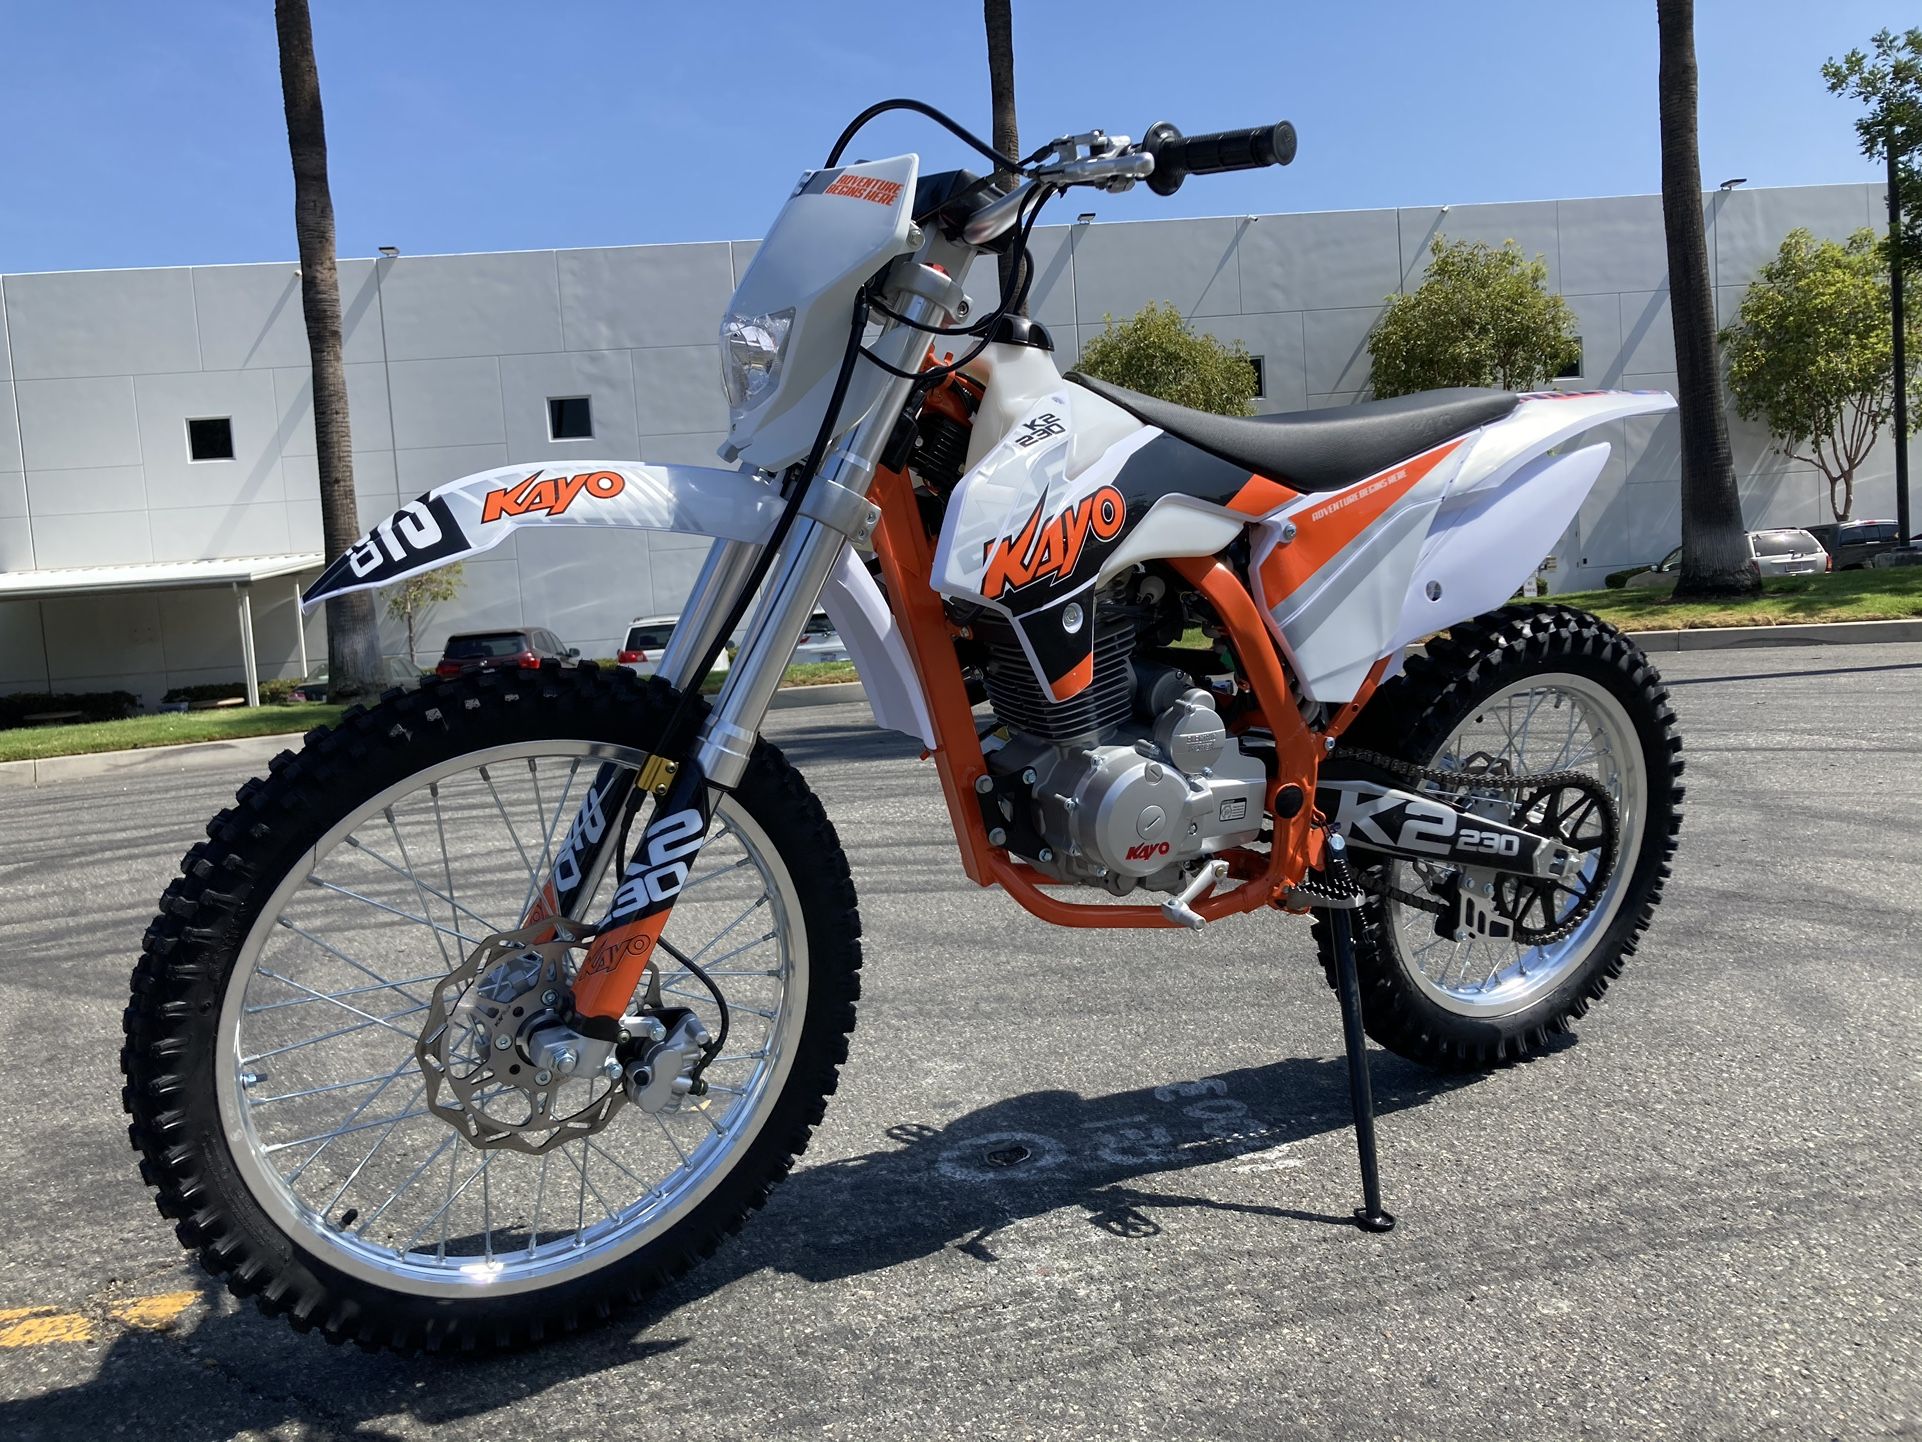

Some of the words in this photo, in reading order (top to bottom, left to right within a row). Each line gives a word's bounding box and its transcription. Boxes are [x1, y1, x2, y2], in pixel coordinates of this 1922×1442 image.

[825, 184, 867, 199] BEGINS
[863, 190, 898, 206] HERE
[835, 174, 905, 195] ADVENTURE
[1023, 413, 1061, 431] K2
[1015, 423, 1066, 448] 230
[480, 469, 626, 524] KAYO
[1311, 493, 1360, 522] ADVENTURE
[980, 482, 1127, 601] KAYO
[1336, 788, 1458, 856] K2
[1455, 828, 1520, 857] 230
[1125, 842, 1170, 861] KAYO
